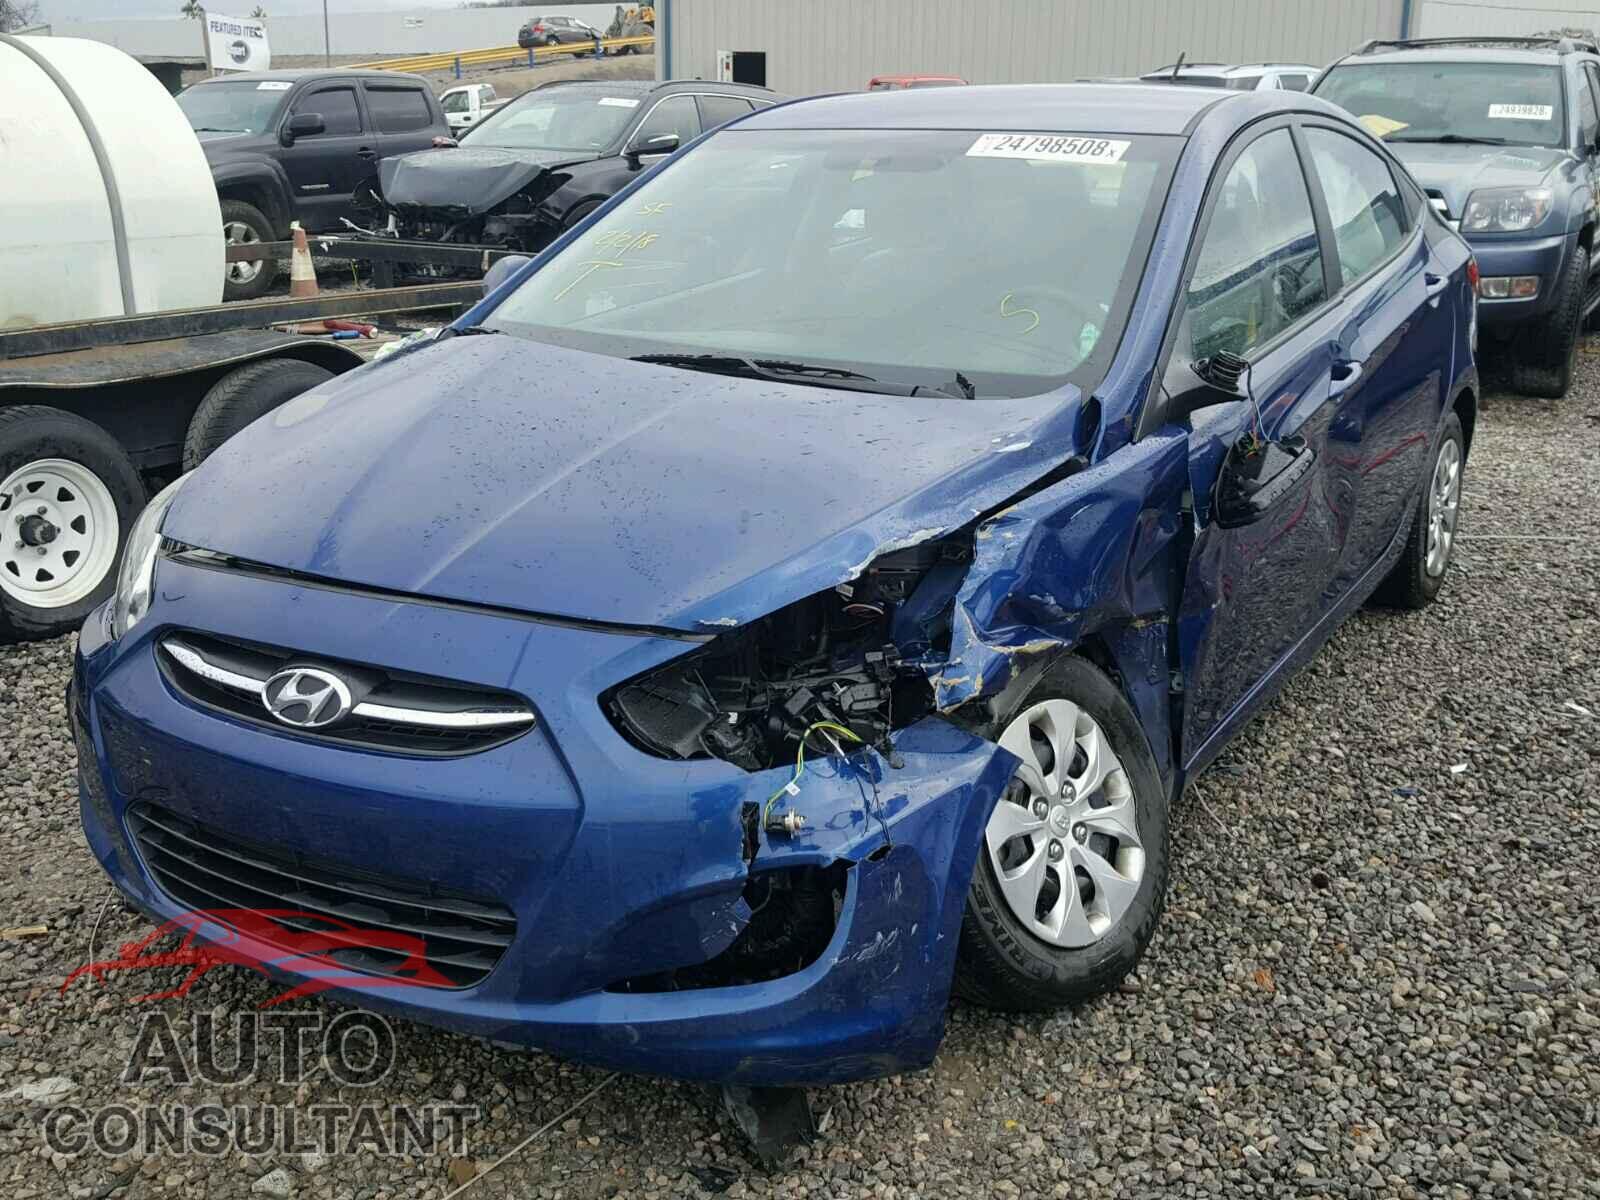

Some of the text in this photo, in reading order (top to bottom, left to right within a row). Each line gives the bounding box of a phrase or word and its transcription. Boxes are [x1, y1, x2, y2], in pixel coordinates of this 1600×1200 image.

[210, 20, 263, 38] FEATURED ITE
[993, 135, 1109, 157] 24798508
